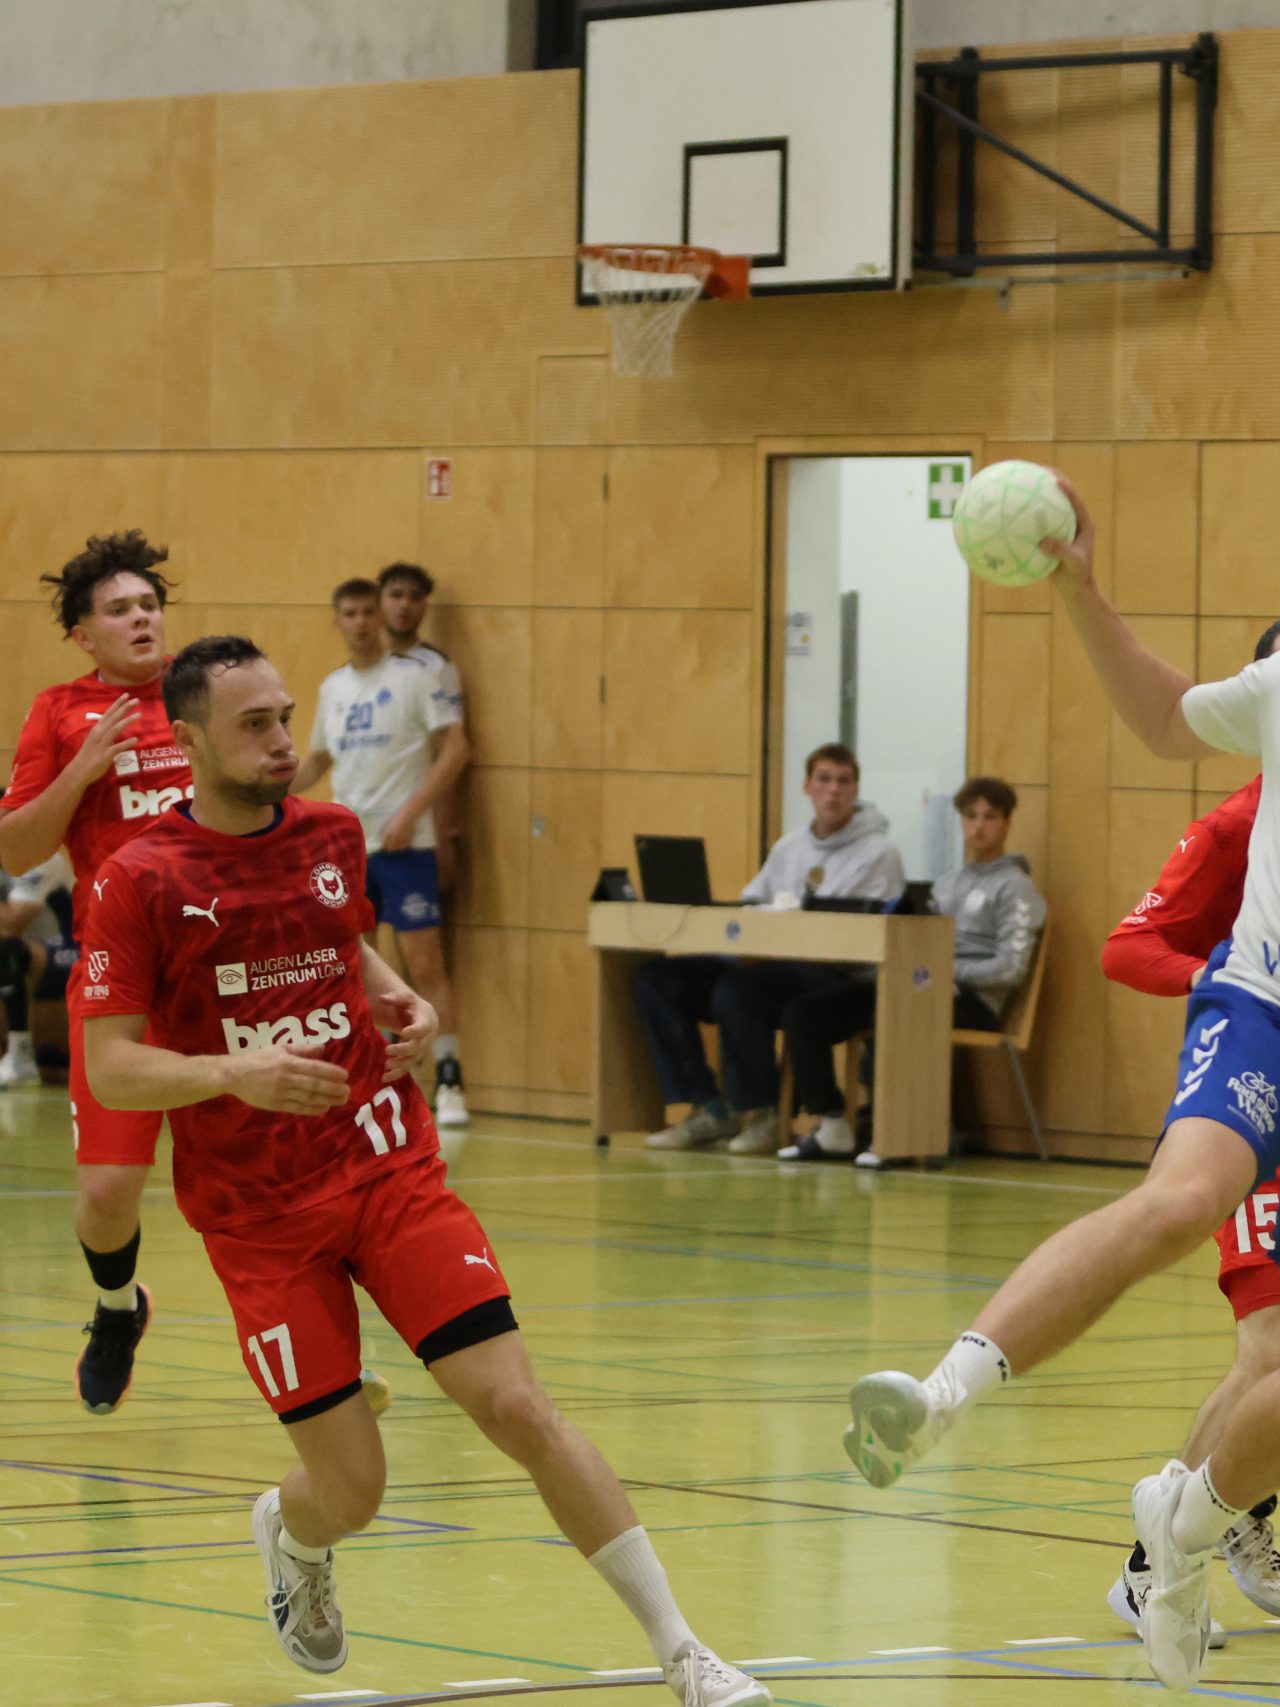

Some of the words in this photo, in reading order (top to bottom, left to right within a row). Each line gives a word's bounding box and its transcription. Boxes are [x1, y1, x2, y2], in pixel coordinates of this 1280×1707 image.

[140, 746, 178, 759] AUGEN
[250, 955, 295, 975] AUGEN
[296, 947, 338, 967] LASER
[251, 967, 318, 991] ZENTRUM
[318, 962, 347, 979] LOHR
[221, 1002, 351, 1055] brass
[354, 1085, 407, 1156] 17
[1234, 1192, 1280, 1254] 15
[247, 1322, 300, 1397] 17
